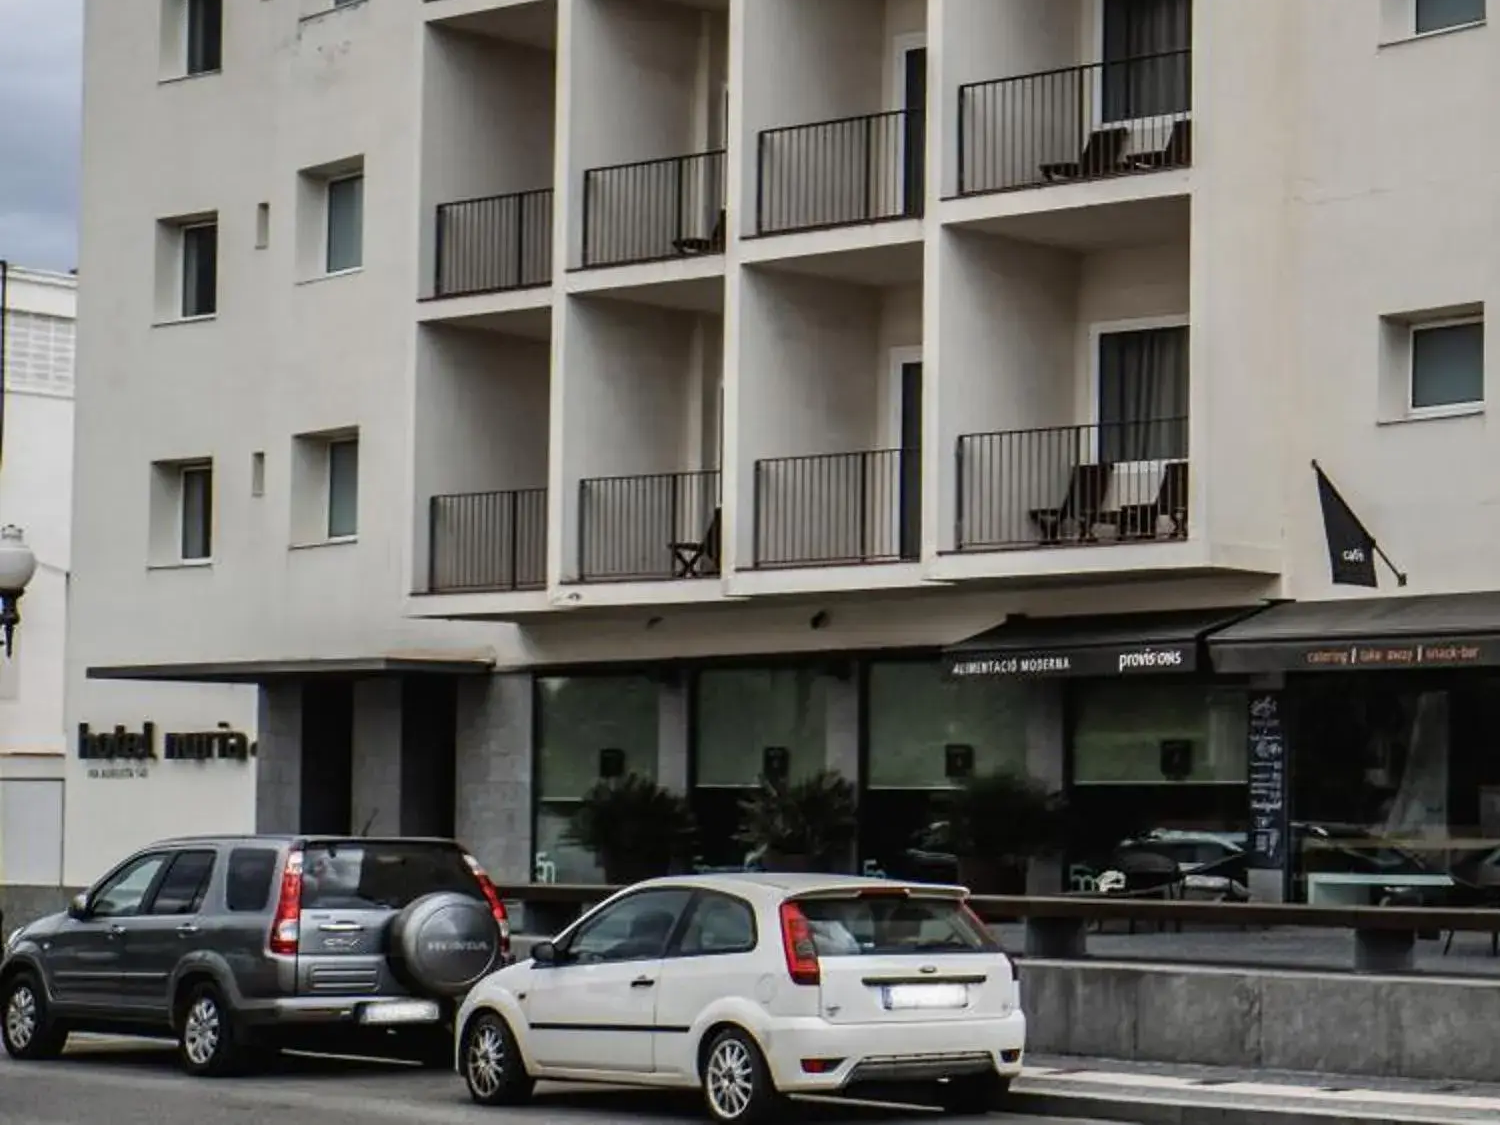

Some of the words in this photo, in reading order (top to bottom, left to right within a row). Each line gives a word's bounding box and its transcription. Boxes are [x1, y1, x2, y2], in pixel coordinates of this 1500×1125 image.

[1020, 656, 1071, 672] MODERNA
[79, 722, 158, 760] hotel
[427, 940, 488, 952] HONDA
